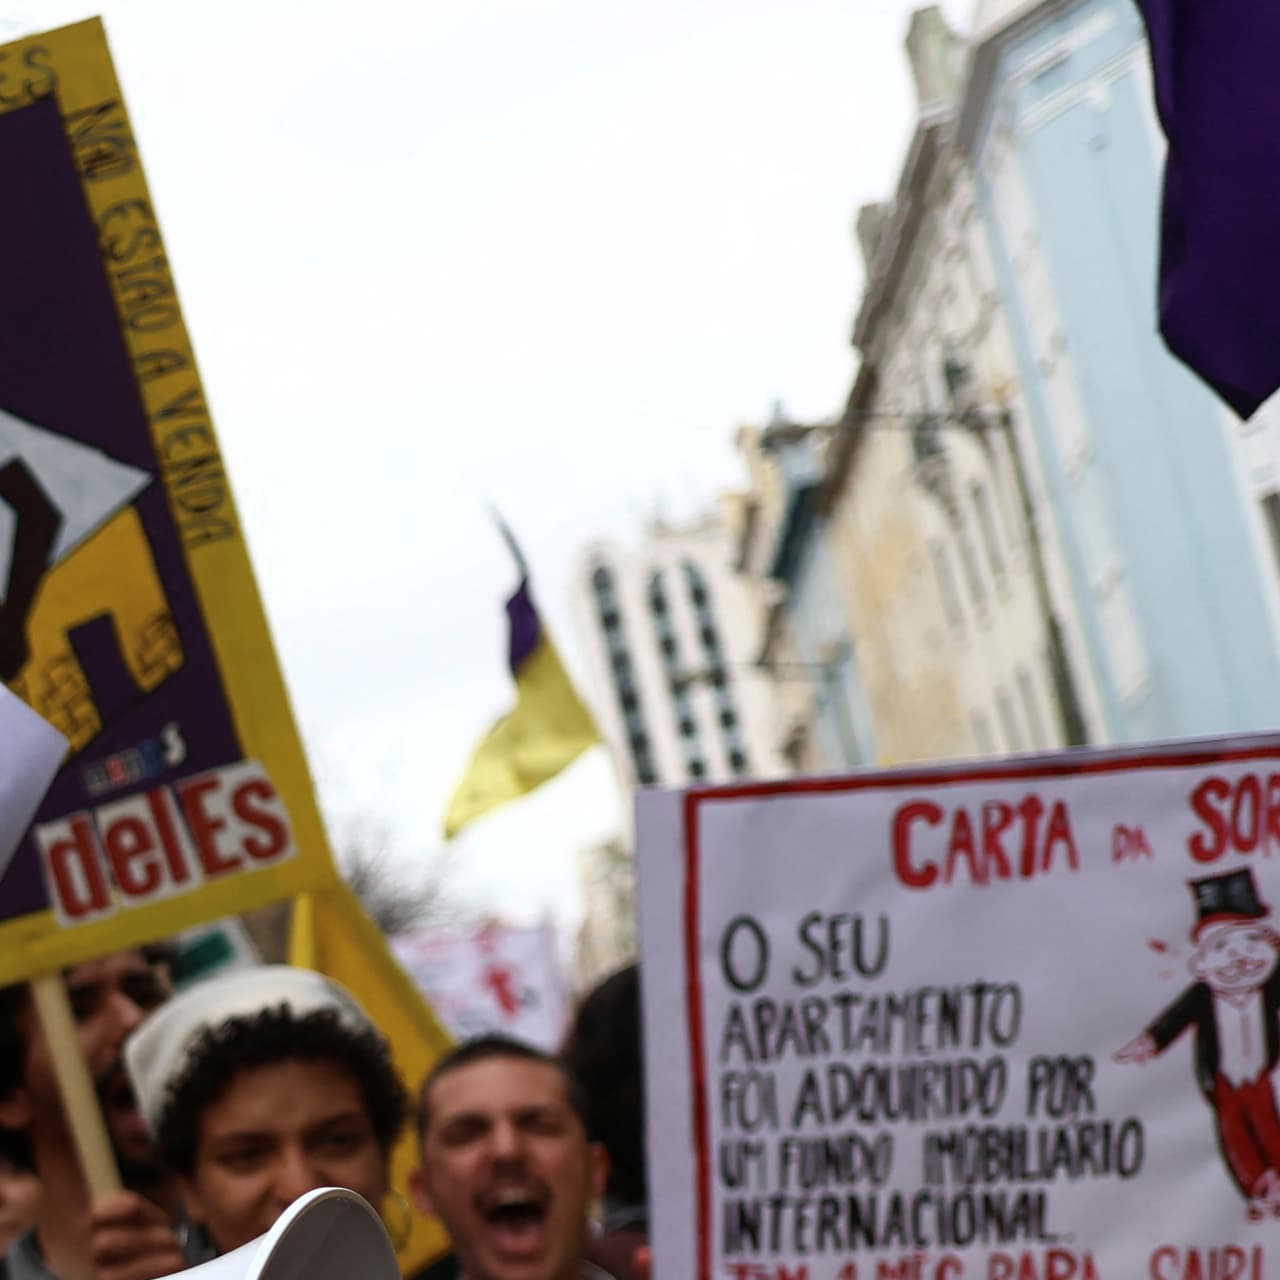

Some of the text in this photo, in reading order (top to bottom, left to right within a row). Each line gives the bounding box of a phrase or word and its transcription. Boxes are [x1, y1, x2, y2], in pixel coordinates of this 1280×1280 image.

[151, 388, 236, 551] VENDA
[892, 793, 1080, 890] CARTA
[1111, 824, 1155, 865] DA
[720, 911, 890, 994] O SEU
[720, 978, 1023, 1064] APARTAMENTO
[720, 1054, 1097, 1134] FOI ADQUIRIDO POR
[719, 1137, 767, 1189] UM
[778, 1130, 893, 1190] FUNDO
